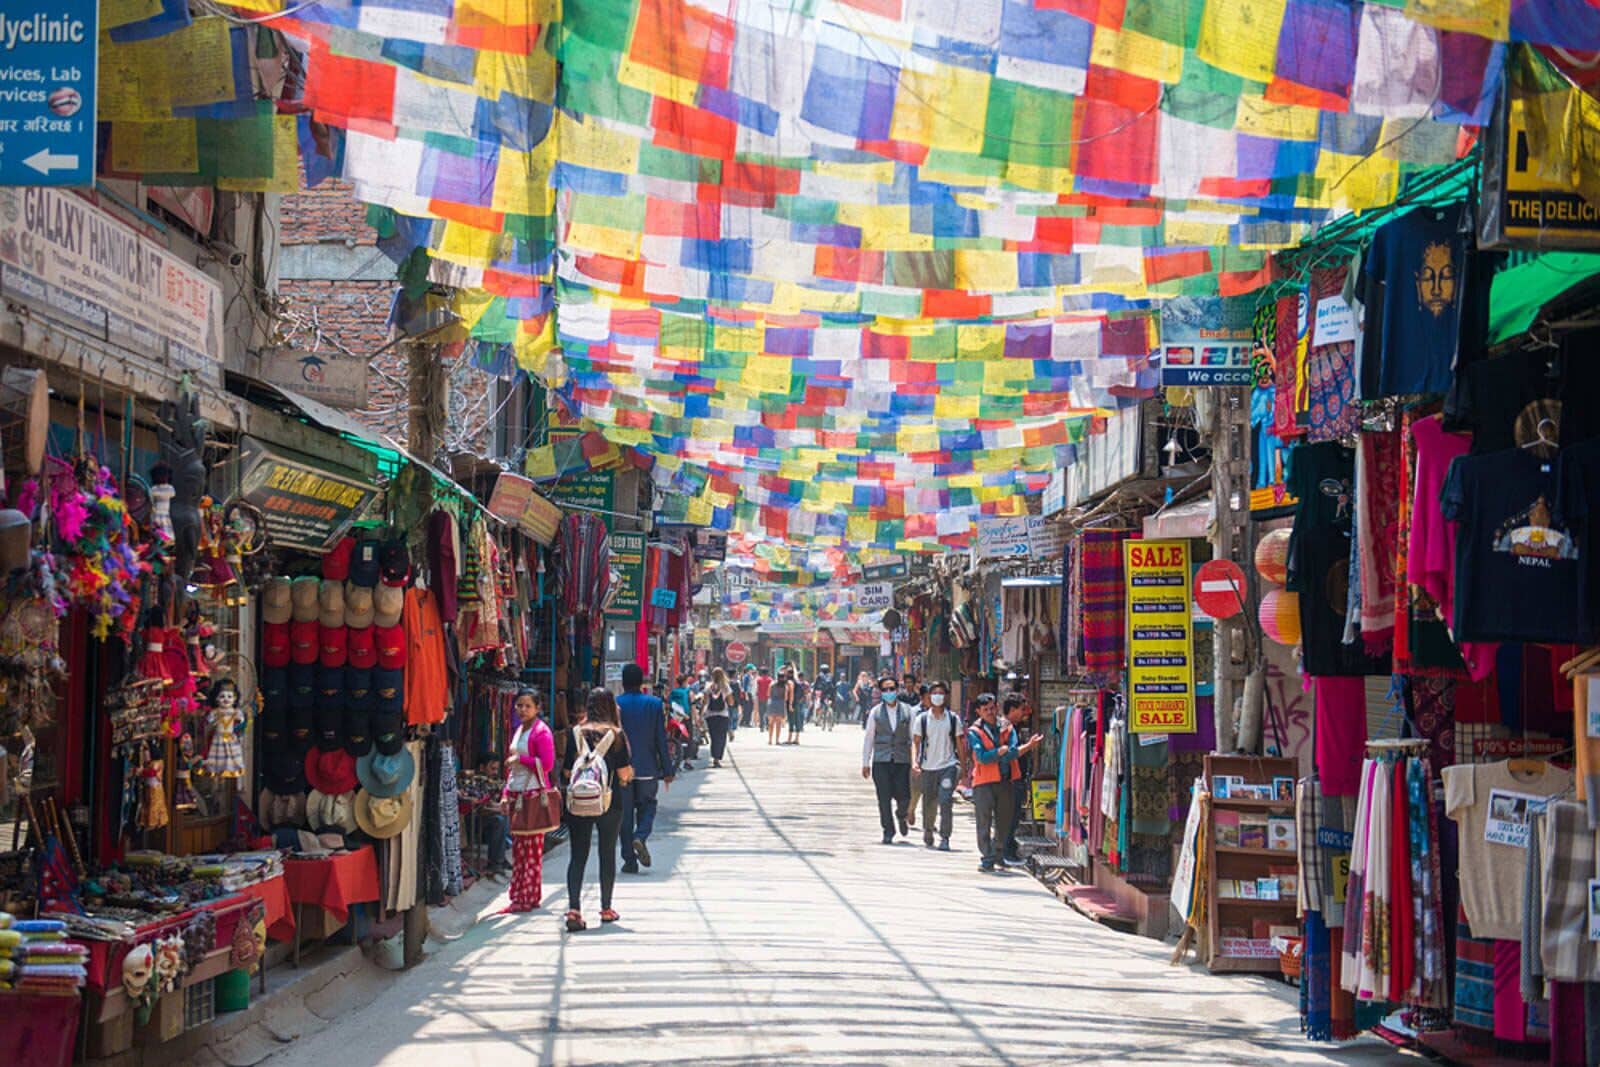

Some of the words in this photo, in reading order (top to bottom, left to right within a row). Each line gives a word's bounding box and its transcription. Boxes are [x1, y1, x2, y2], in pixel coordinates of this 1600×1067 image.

[51, 67, 81, 81] Lab
[1509, 200, 1541, 219] THE
[25, 187, 85, 256] GALAXY
[1188, 371, 1209, 382] We
[1131, 546, 1183, 567] SALE
[1518, 555, 1551, 569] NEPAL
[864, 586, 883, 595] SIM
[860, 596, 889, 606] CARD
[1140, 713, 1184, 723] SALE
